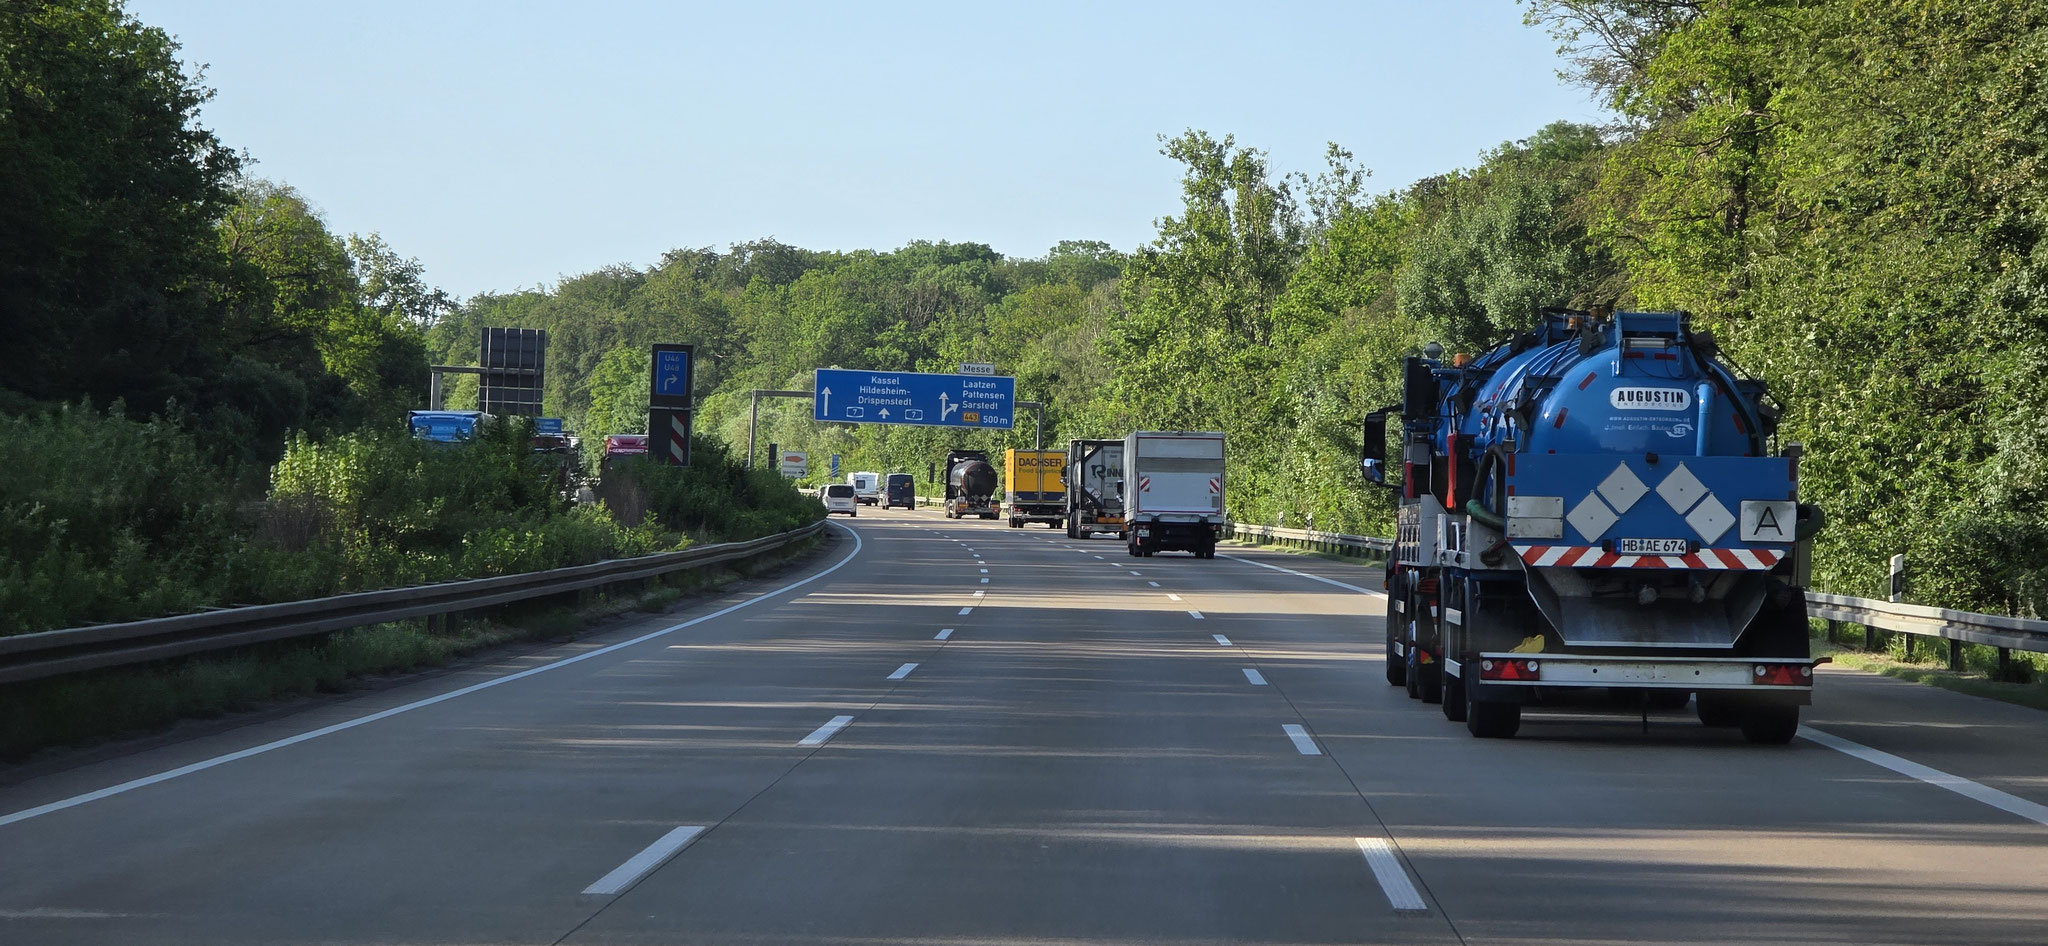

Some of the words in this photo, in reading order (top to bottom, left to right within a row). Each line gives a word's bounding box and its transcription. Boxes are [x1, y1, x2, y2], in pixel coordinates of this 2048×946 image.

[963, 364, 991, 374] Messe
[871, 376, 900, 385] Kassel
[963, 380, 996, 389] Laatzen
[859, 386, 911, 396] Hildesheim-
[962, 390, 1005, 400] Pattensen
[858, 396, 912, 407] Drispenstedt
[1617, 390, 1684, 404] AUGUSTIN
[962, 400, 998, 410] Sarstedt
[852, 408, 858, 416] 7
[964, 412, 978, 422] 443
[983, 415, 999, 424] 500
[1000, 417, 1008, 425] m
[1018, 457, 1062, 468] DACHSER
[1753, 505, 1784, 537] A
[1622, 540, 1639, 552] HB
[1645, 540, 1662, 552] AE
[1663, 540, 1686, 553] 674
